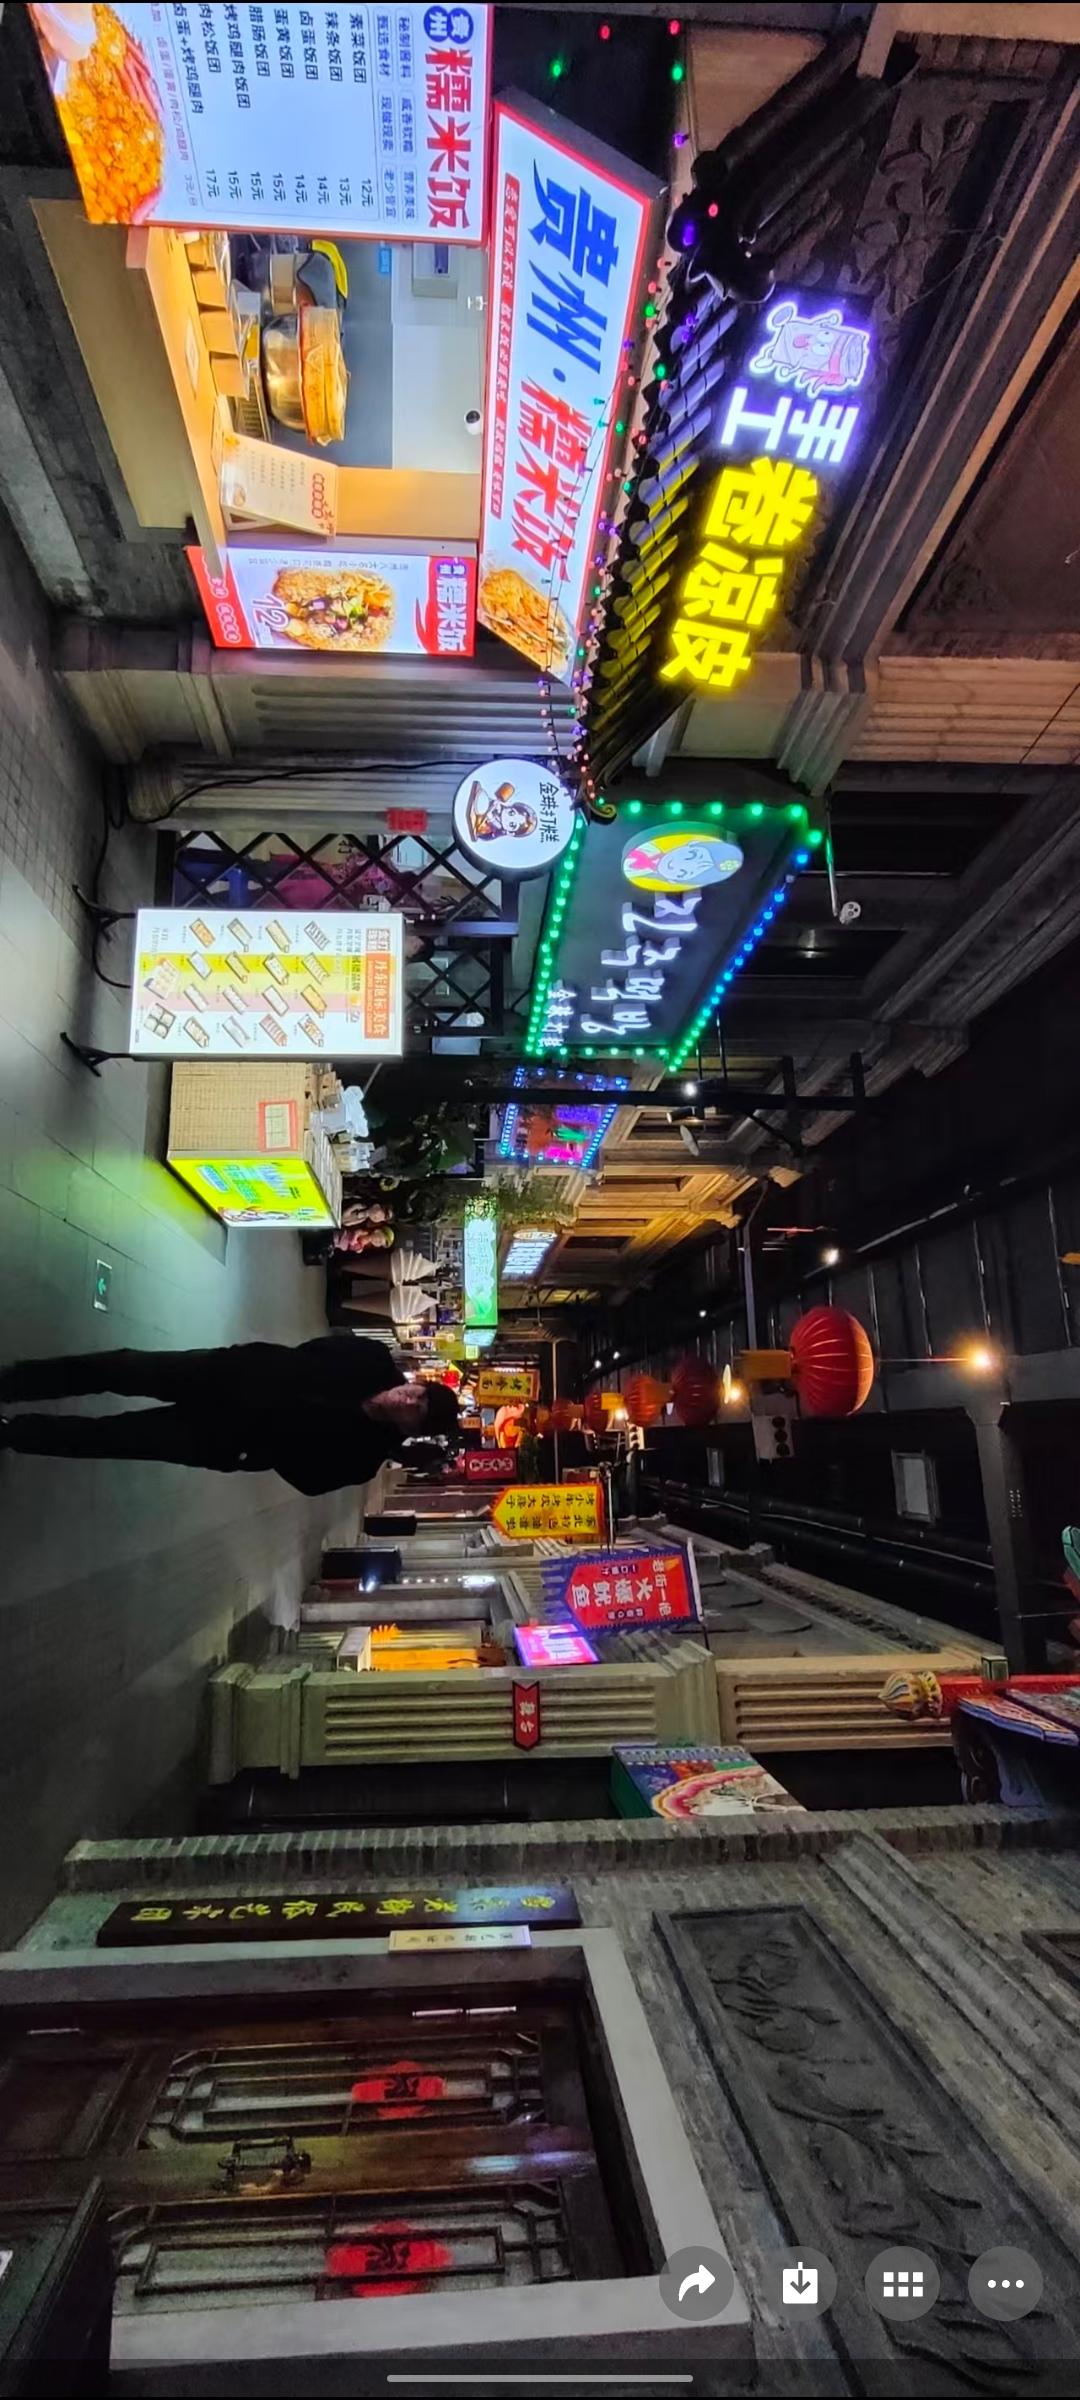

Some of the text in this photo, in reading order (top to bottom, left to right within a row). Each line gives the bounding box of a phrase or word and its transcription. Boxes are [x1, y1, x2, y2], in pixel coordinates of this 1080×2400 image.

[173, 3, 220, 198] 卤蛋+烤鸡腿肉 17元
[199, 3, 242, 199] 肉松饭团 15元
[223, 3, 264, 200] 烤鸡腿肉饭团 15元
[248, 5, 286, 201] 腊肠饭团 15元
[274, 8, 307, 203] 蛋黄饭团 14元
[299, 10, 329, 205] 卤蛋饭团 14元
[325, 11, 351, 206] 辣条饭团 13元
[349, 13, 373, 207] 素菜饭团 12元
[377, 15, 396, 218] 甄选食材 现做现卖 老少皆宜
[424, 10, 473, 229] 贵州 糯米饭
[251, 595, 288, 629] 12
[436, 577, 468, 652] 糯米饭
[660, 387, 859, 688] 手工 卷凉皮
[539, 781, 561, 844] 金珠打糕
[374, 959, 389, 1036] 丹东地标美食
[539, 982, 576, 1048] 金珠打糕
[580, 893, 703, 1035] 진주떡방
[548, 1514, 595, 1529] 东北特色
[572, 1577, 653, 1609] 火爆鱿鱼
